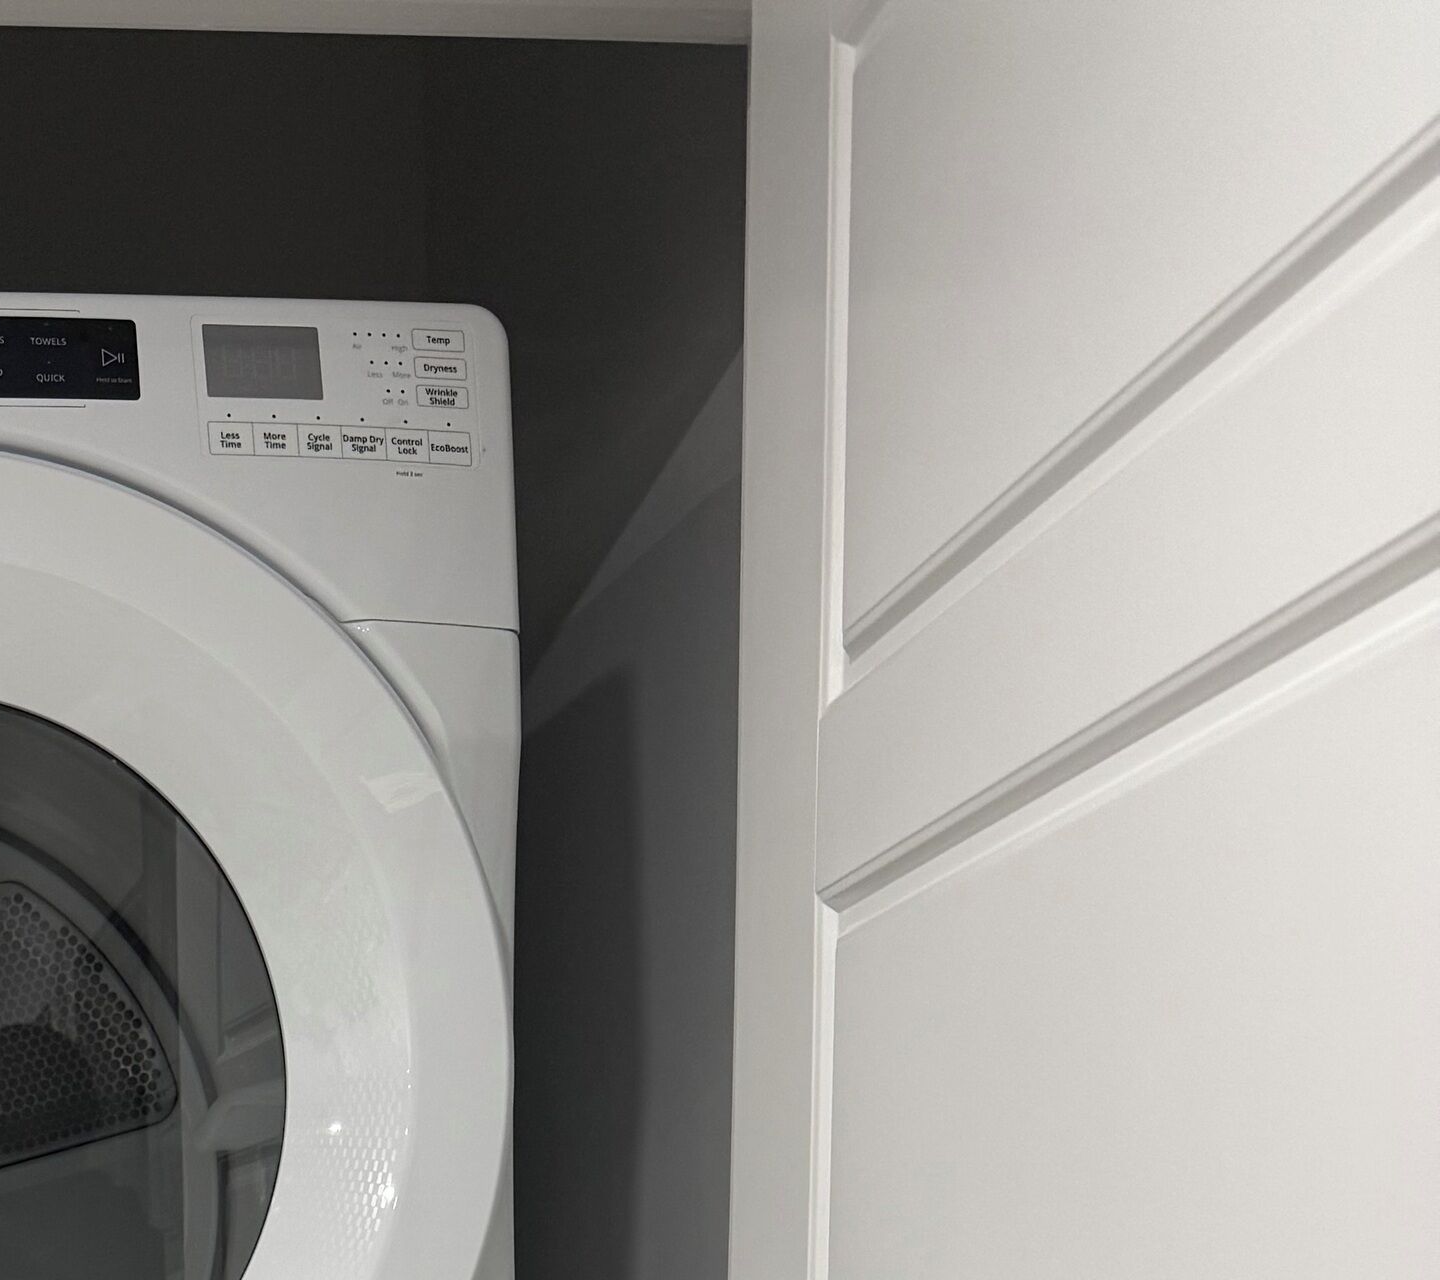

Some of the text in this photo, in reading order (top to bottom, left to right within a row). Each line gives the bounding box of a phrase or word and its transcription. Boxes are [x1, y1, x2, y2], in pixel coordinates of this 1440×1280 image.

[29, 337, 67, 346] TOWELS
[426, 335, 451, 346] Temp
[423, 363, 458, 374] Dryness
[36, 373, 66, 383] QUICK
[425, 387, 458, 398] Wrinkle
[429, 397, 456, 406] Shield
[220, 431, 240, 440] Less
[263, 432, 286, 441] More
[307, 433, 331, 444] Cycle
[342, 434, 384, 447] Damp Dry
[220, 440, 242, 449] Time
[264, 440, 287, 450] Time
[306, 441, 333, 452] Signal
[391, 437, 423, 447] Control
[351, 444, 377, 454] Signal
[398, 446, 418, 456] Lock
[430, 444, 469, 454] EcoBoost
